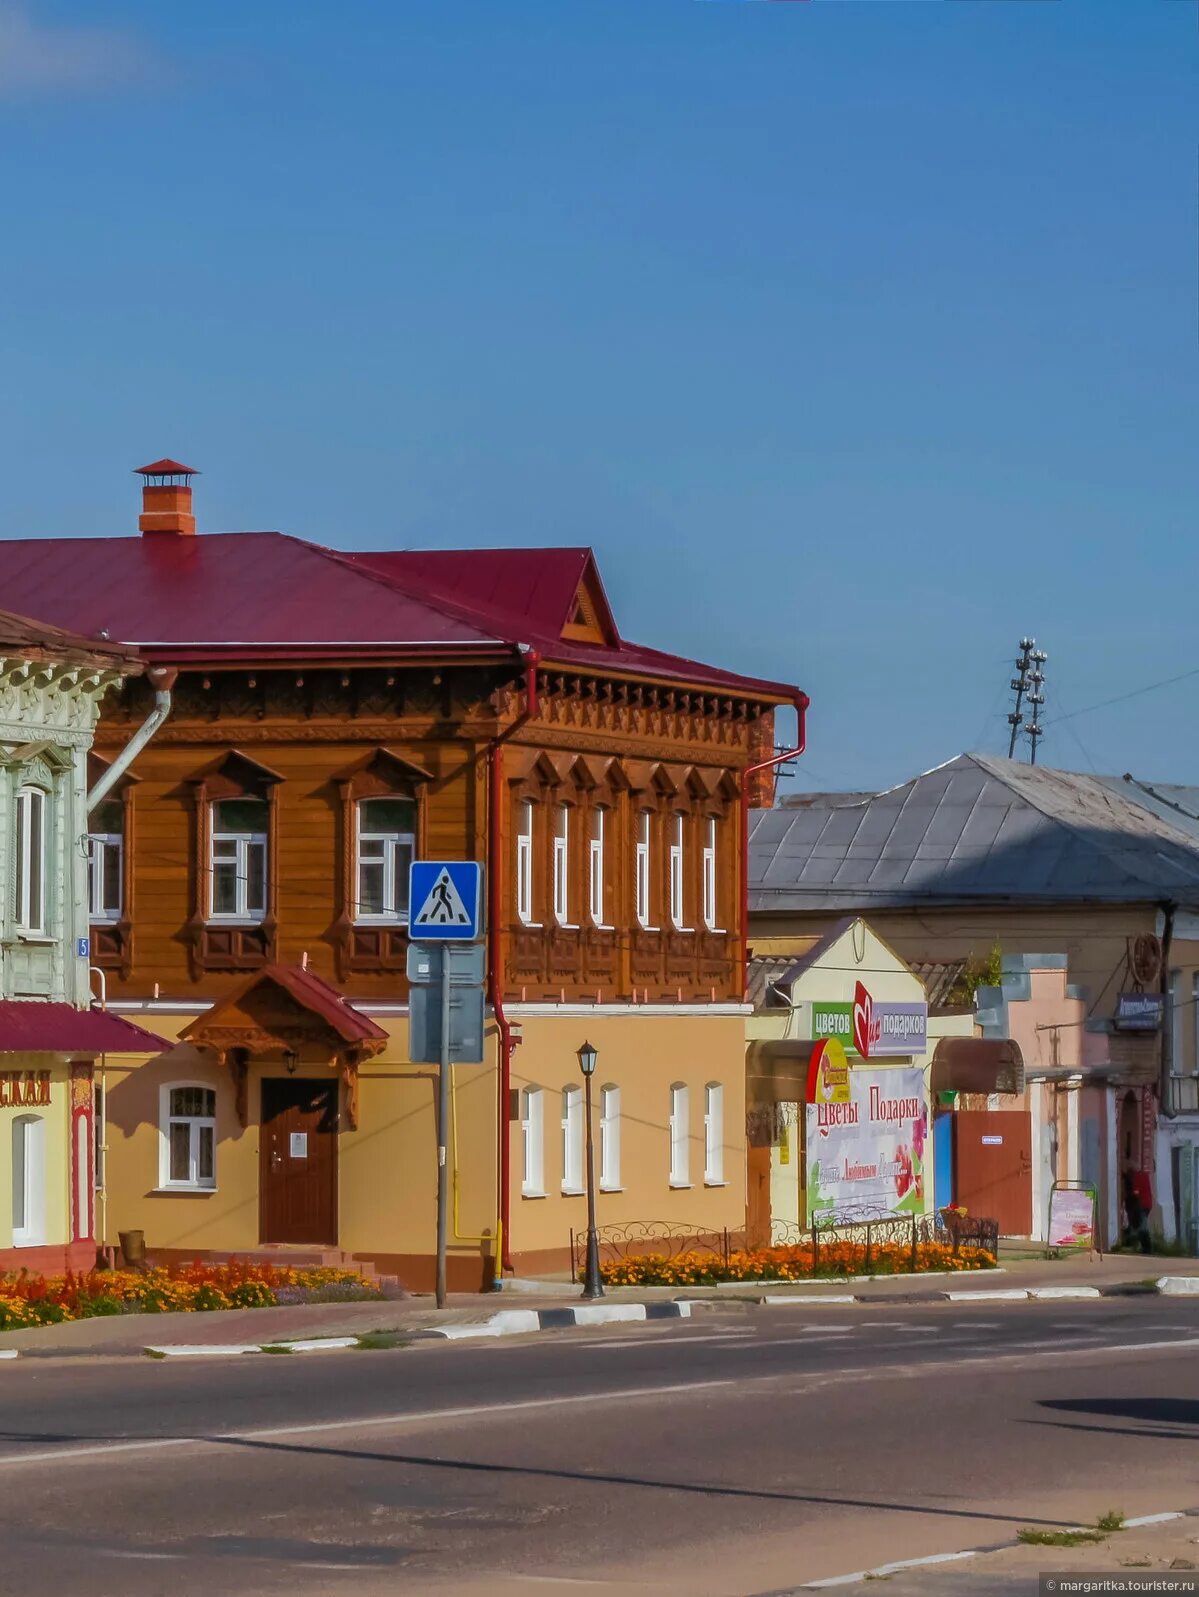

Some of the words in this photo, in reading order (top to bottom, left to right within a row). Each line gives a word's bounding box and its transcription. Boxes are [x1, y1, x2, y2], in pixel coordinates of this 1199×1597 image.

[80, 939, 87, 956] 5
[815, 1012, 850, 1037] цветов
[883, 1014, 924, 1041] подарков
[817, 1101, 859, 1137] Цветы
[869, 1085, 919, 1128] Подарки
